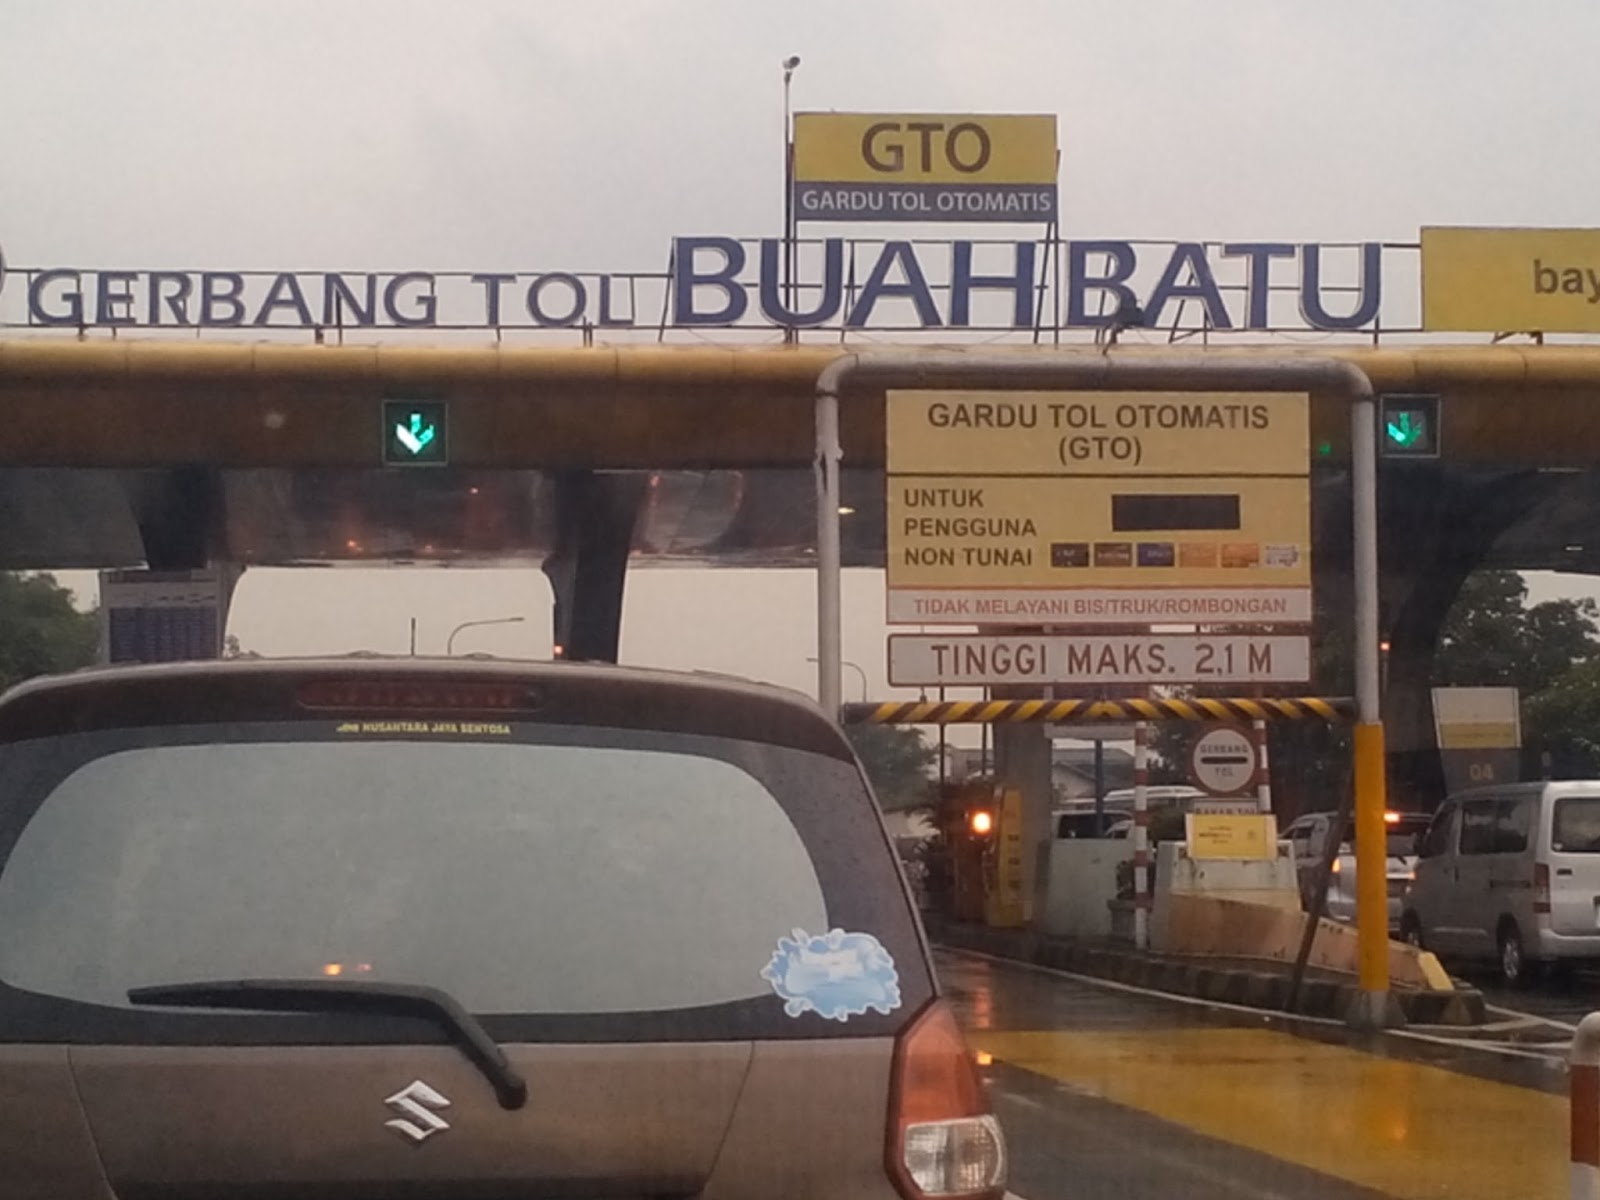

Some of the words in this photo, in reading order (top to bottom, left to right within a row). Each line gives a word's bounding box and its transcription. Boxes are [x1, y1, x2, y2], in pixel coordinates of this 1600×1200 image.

[861, 121, 993, 173] GTO
[801, 189, 884, 212] GARDU
[887, 190, 931, 212] TOL
[936, 190, 1052, 214] OTOMATIS
[671, 236, 1037, 328] BUAH
[27, 268, 437, 328] GERBANG
[471, 272, 635, 326] TOL
[927, 403, 1038, 429] GARDU
[1047, 404, 1106, 429] TOL
[1115, 404, 1270, 430] OTOMATIS
[1058, 436, 1143, 466] (GTO)
[903, 489, 985, 508] UNTUK
[903, 518, 1037, 537] PENGGUNA
[904, 547, 958, 566] NON
[962, 548, 1033, 566] TUNAI
[913, 599, 970, 615] TIDAK
[975, 599, 1068, 615] MELAYANI
[1074, 598, 1287, 614] BIS/TRUK/ROMBONGAN
[931, 644, 1047, 676] TINGGI
[1067, 644, 1176, 676] MAKS.
[1248, 644, 1272, 676] M
[362, 721, 429, 734] NUSANTARA
[460, 723, 511, 735] SENTOSA
[1200, 744, 1249, 754] GERBANG
